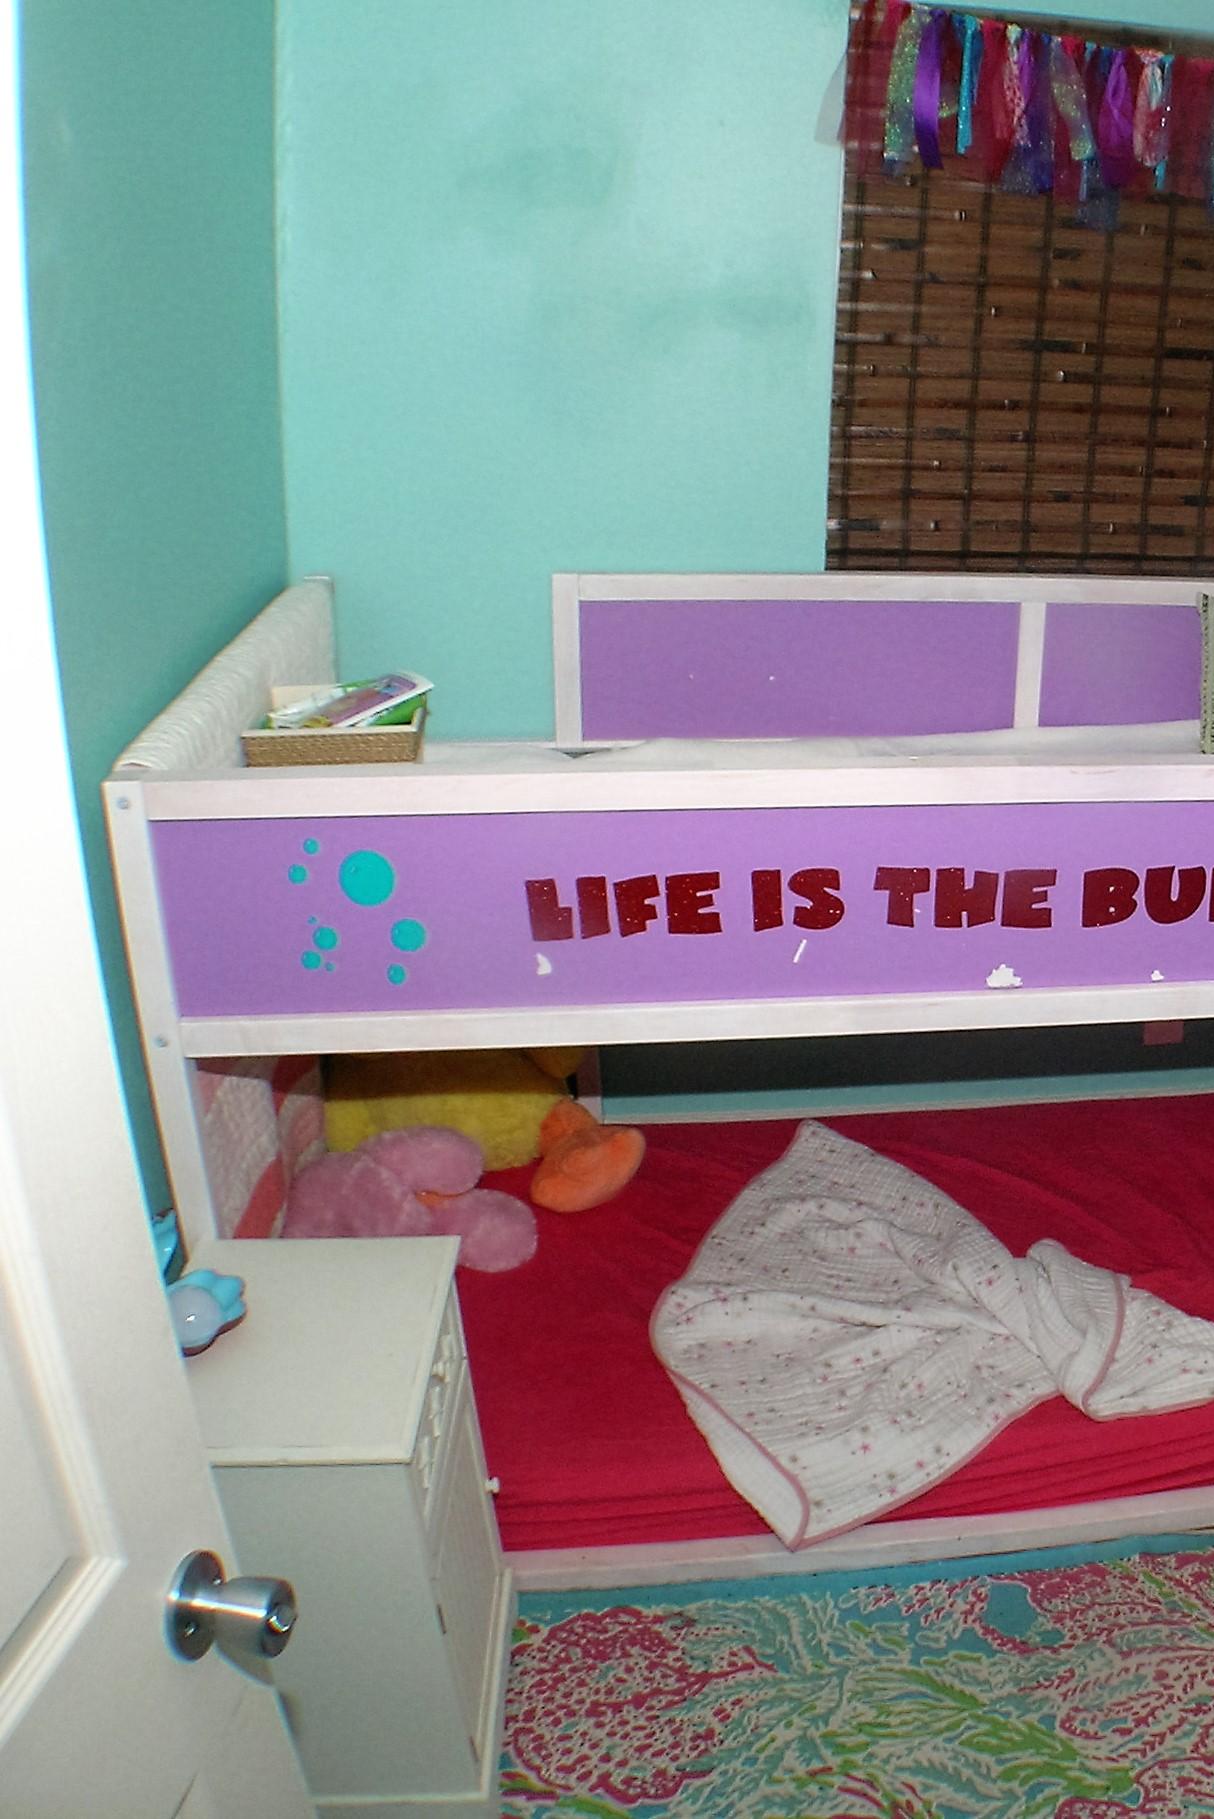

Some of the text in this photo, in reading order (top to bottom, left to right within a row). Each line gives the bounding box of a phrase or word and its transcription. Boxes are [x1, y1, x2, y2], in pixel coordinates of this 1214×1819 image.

[525, 871, 723, 942] LIFE
[751, 867, 845, 932] IS
[873, 866, 1058, 929] THE
